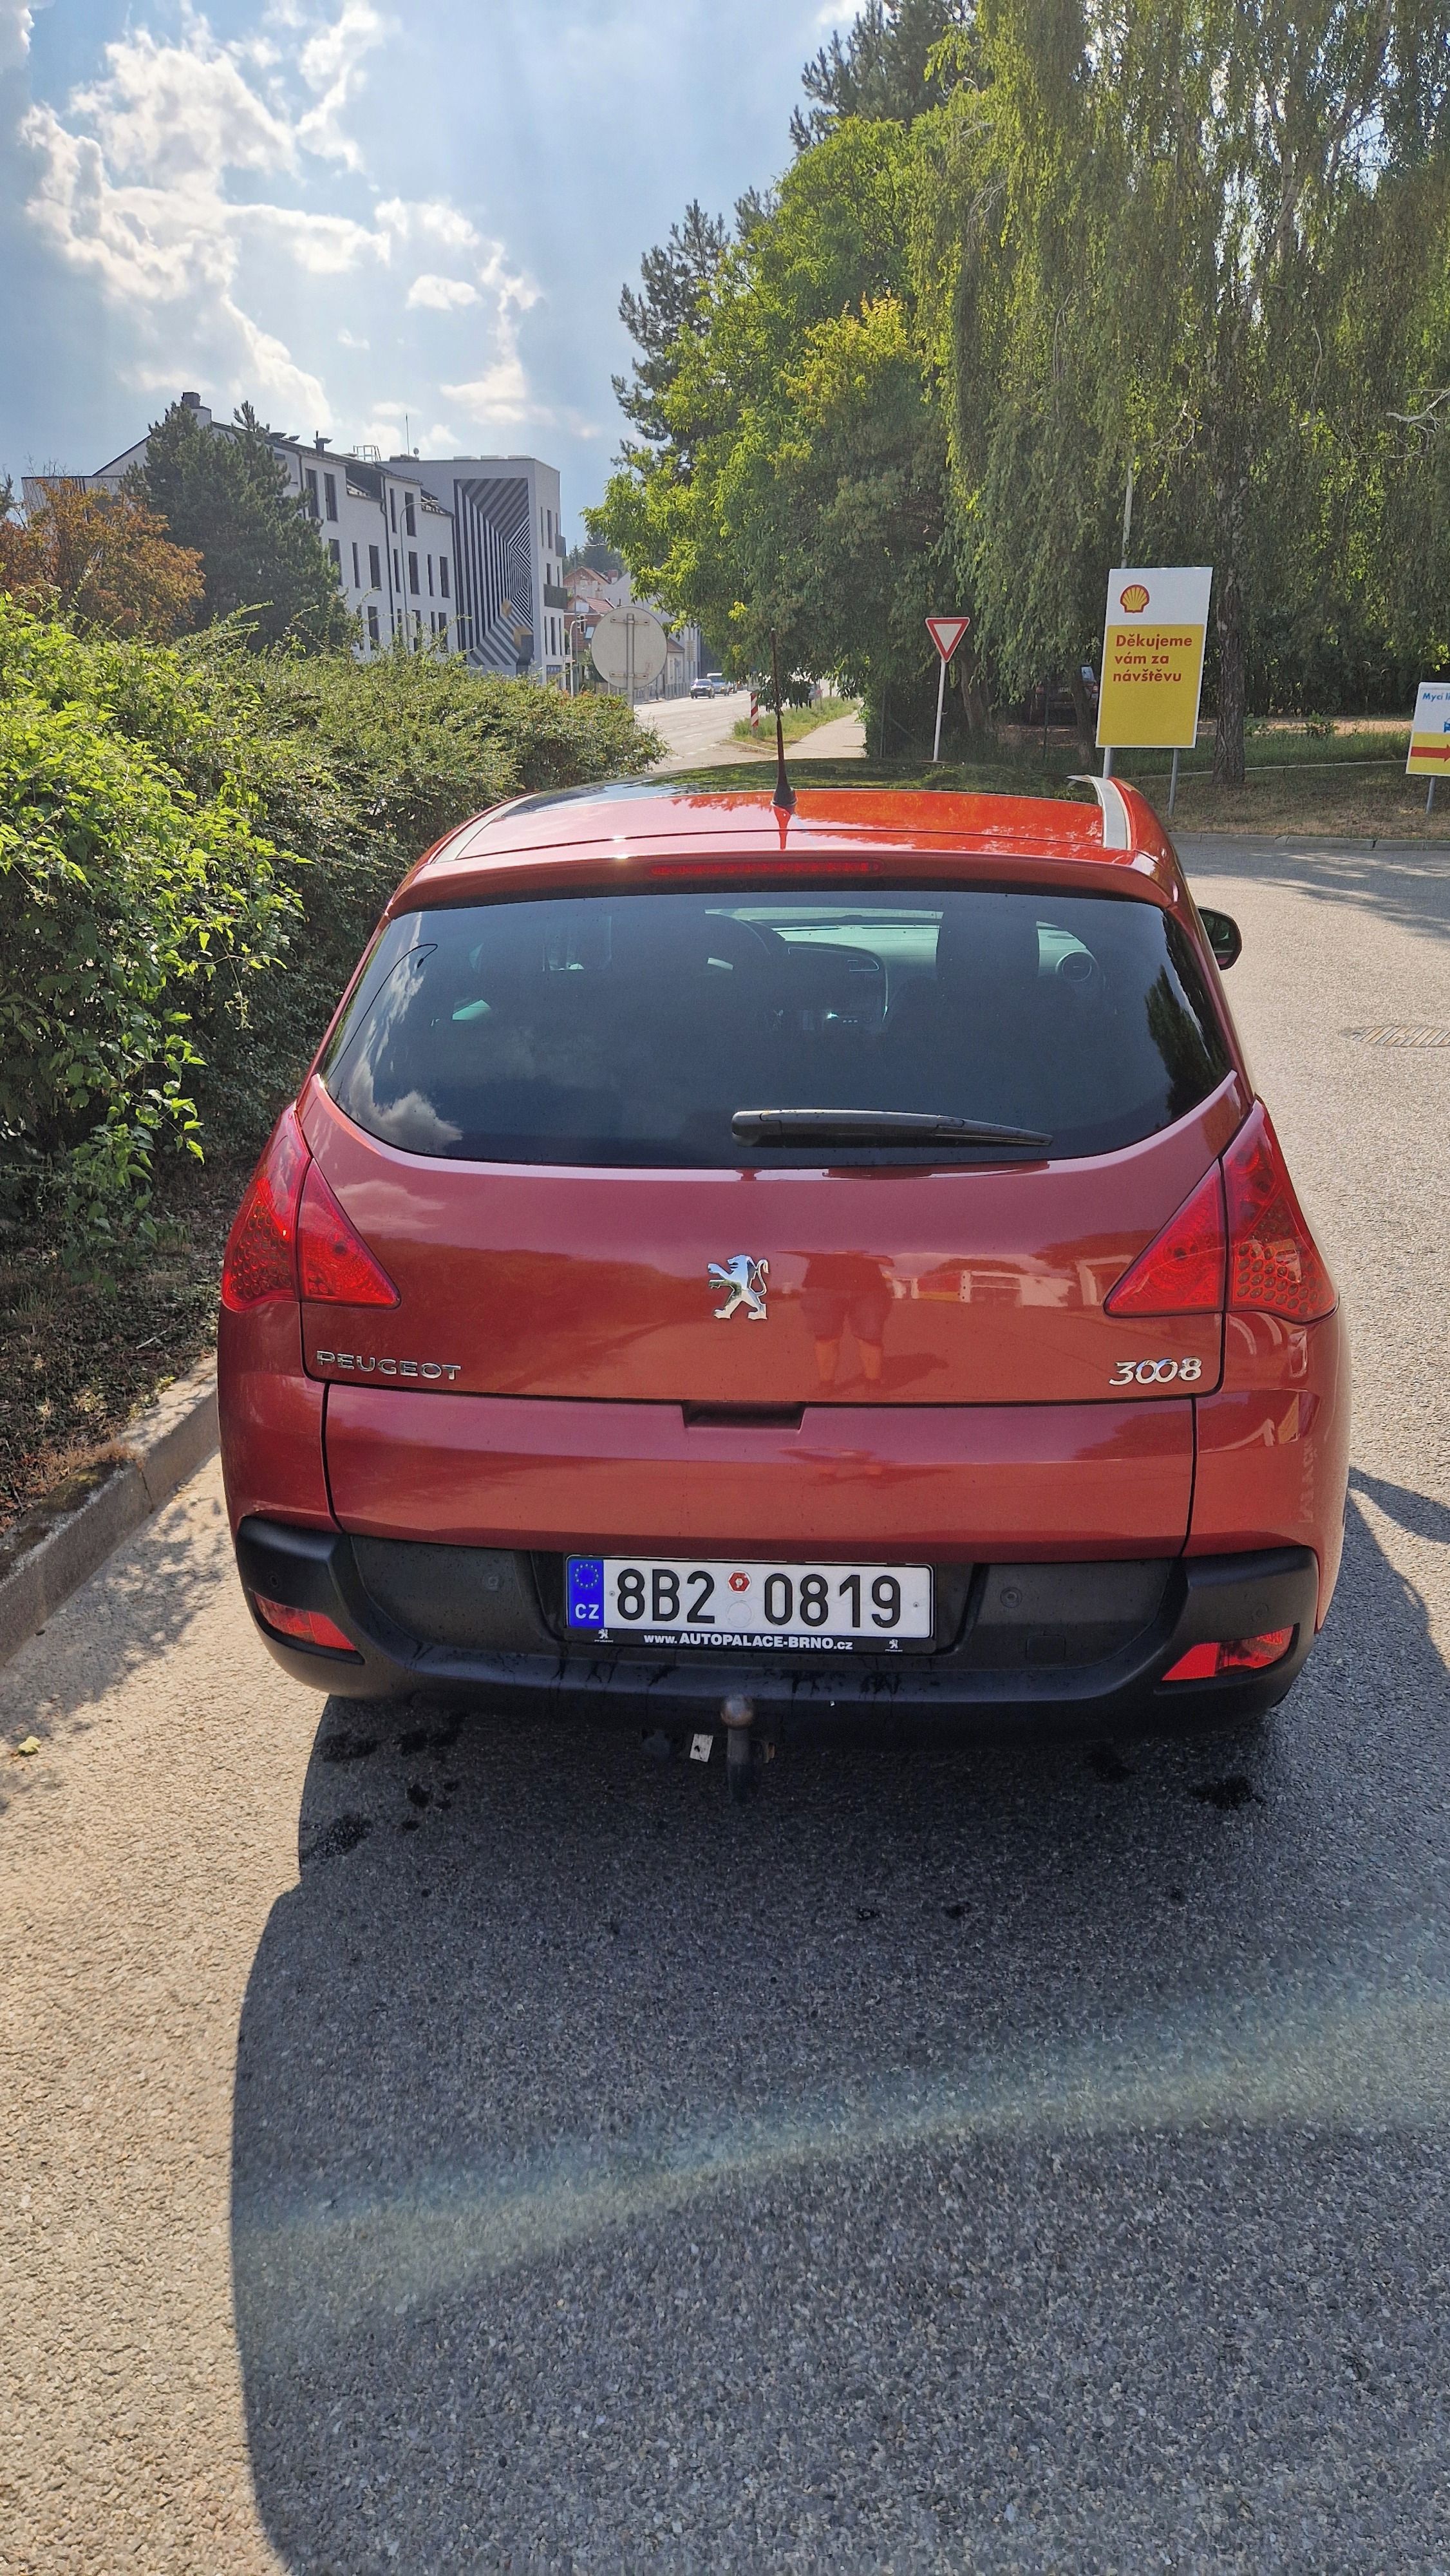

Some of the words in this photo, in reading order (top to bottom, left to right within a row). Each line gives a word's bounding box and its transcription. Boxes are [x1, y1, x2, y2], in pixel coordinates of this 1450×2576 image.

[1116, 634, 1192, 650] Děkujeme
[1115, 652, 1147, 664] vám
[1151, 655, 1169, 664] za
[1113, 669, 1182, 682] návštěvu
[317, 1350, 461, 1380] PEUGEOT
[1109, 1356, 1202, 1385] 3008
[617, 1568, 715, 1624] 8B2
[764, 1573, 901, 1629] 0819
[575, 1603, 599, 1620] CZ
[644, 1633, 853, 1650] www.AUTOPALACE-BRNO.cz
